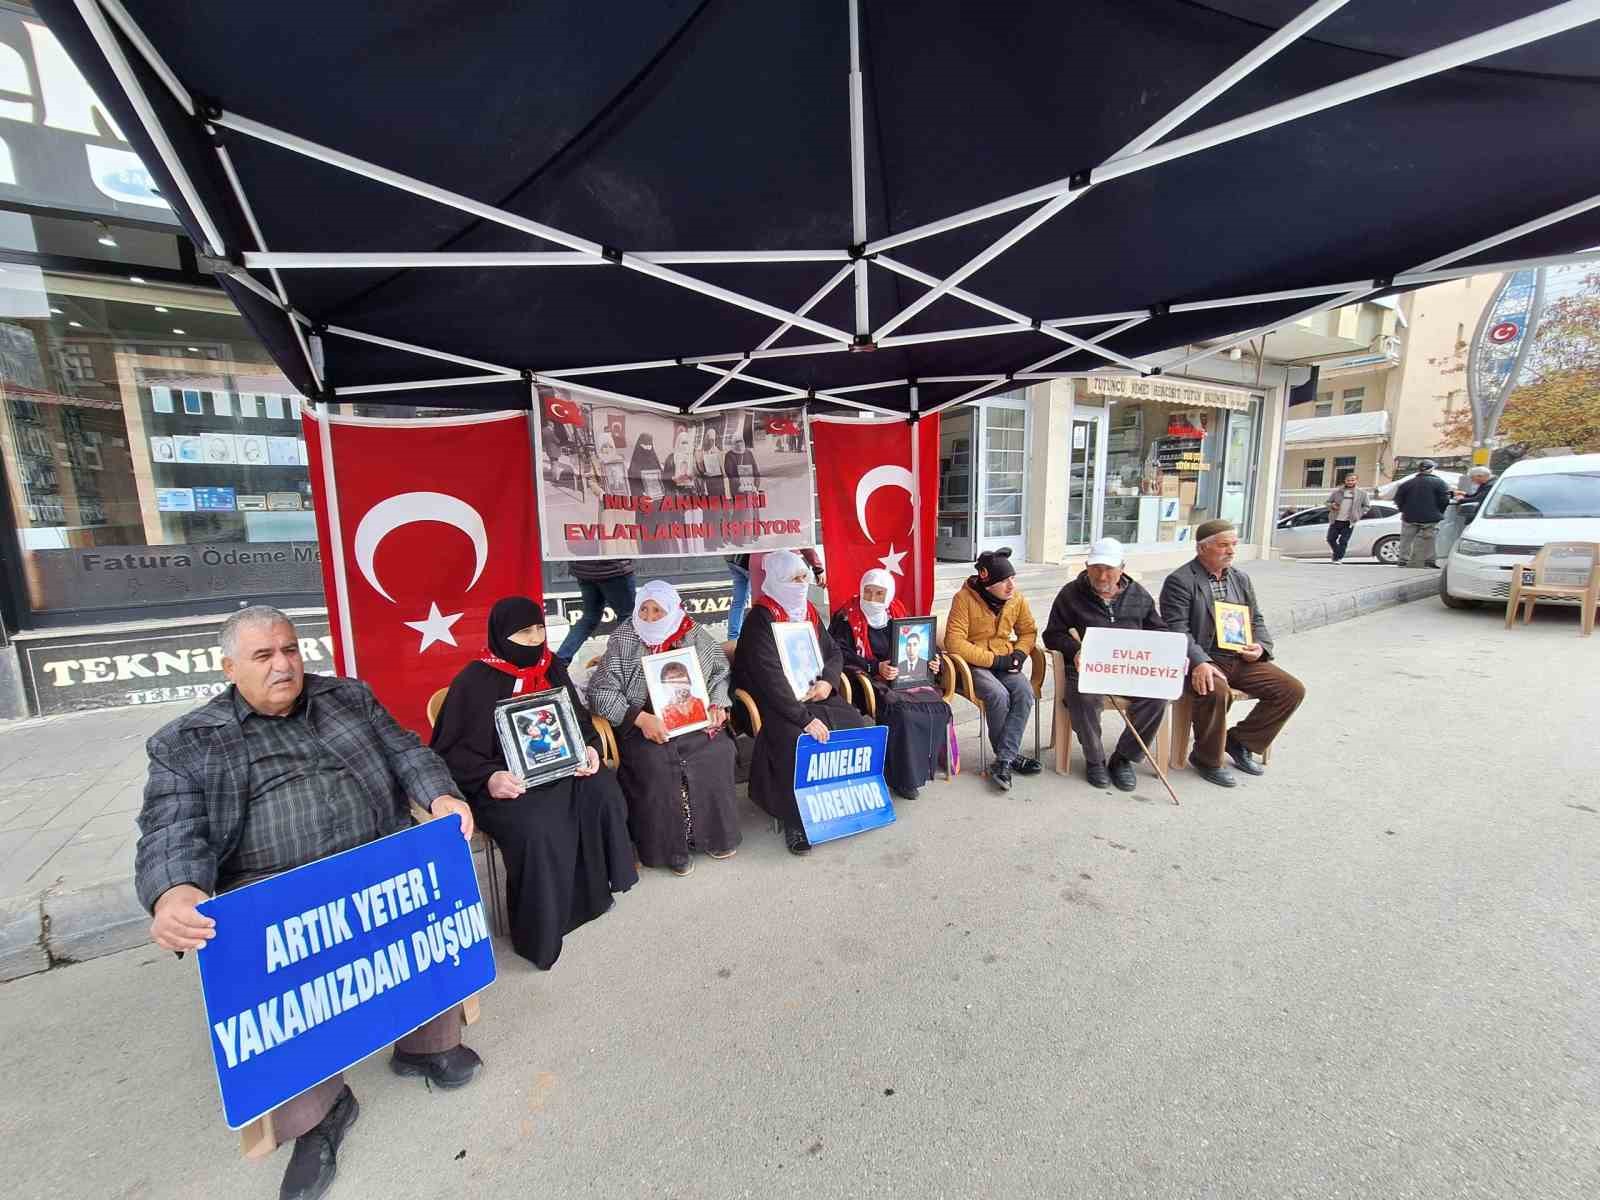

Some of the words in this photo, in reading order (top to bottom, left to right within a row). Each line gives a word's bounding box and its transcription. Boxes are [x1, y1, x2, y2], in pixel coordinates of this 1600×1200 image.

[82, 552, 192, 572] Fatura
[202, 547, 286, 566] Ödeme
[1085, 661, 1179, 679] NÖBETİNDEYİZ
[1112, 649, 1152, 661] EVLAT
[807, 746, 873, 783] ANNELER
[806, 779, 885, 823] DİRENİYOR
[265, 897, 353, 974] ARTIK
[351, 868, 429, 933] YETER
[214, 939, 411, 1069] YAKAMIZDAN
[411, 899, 489, 973] DÜŞÜN
